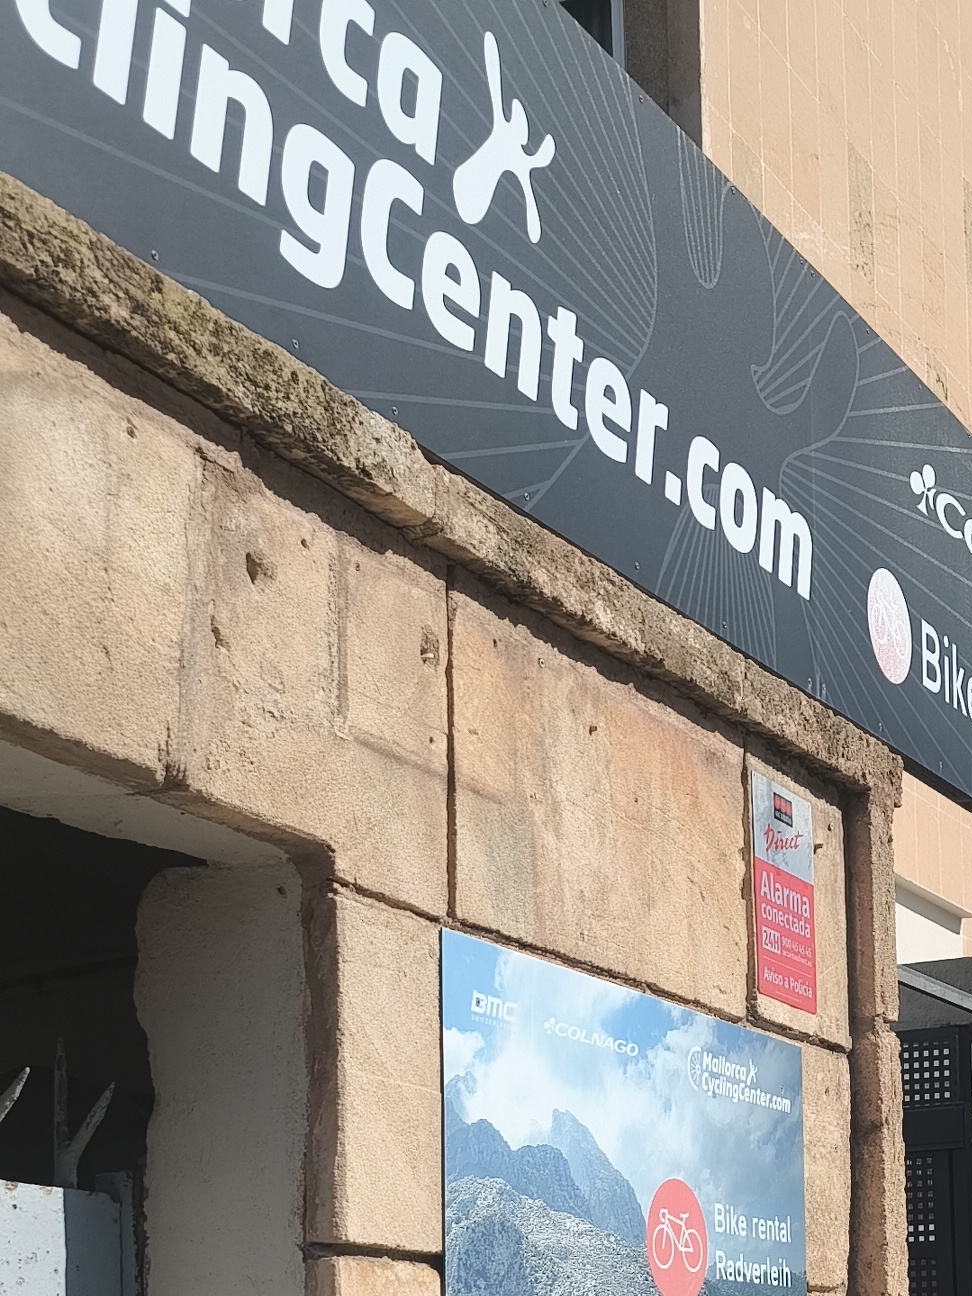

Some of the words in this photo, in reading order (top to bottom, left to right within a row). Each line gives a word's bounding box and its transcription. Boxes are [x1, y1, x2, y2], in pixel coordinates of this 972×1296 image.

[763, 822, 804, 853] Direct
[761, 871, 810, 918] Alarma
[761, 903, 811, 939] conectada
[763, 928, 780, 954] 24H
[763, 967, 783, 987] Aviso
[784, 975, 789, 989] a
[471, 990, 518, 1022] BMC
[554, 1022, 640, 1057] COLNAGO
[703, 1051, 747, 1081] Mallorca
[702, 1072, 791, 1113] CyclingCenter.com
[713, 1202, 747, 1239] Bike
[752, 1215, 791, 1243] rental
[715, 1250, 792, 1288] Radverleih
